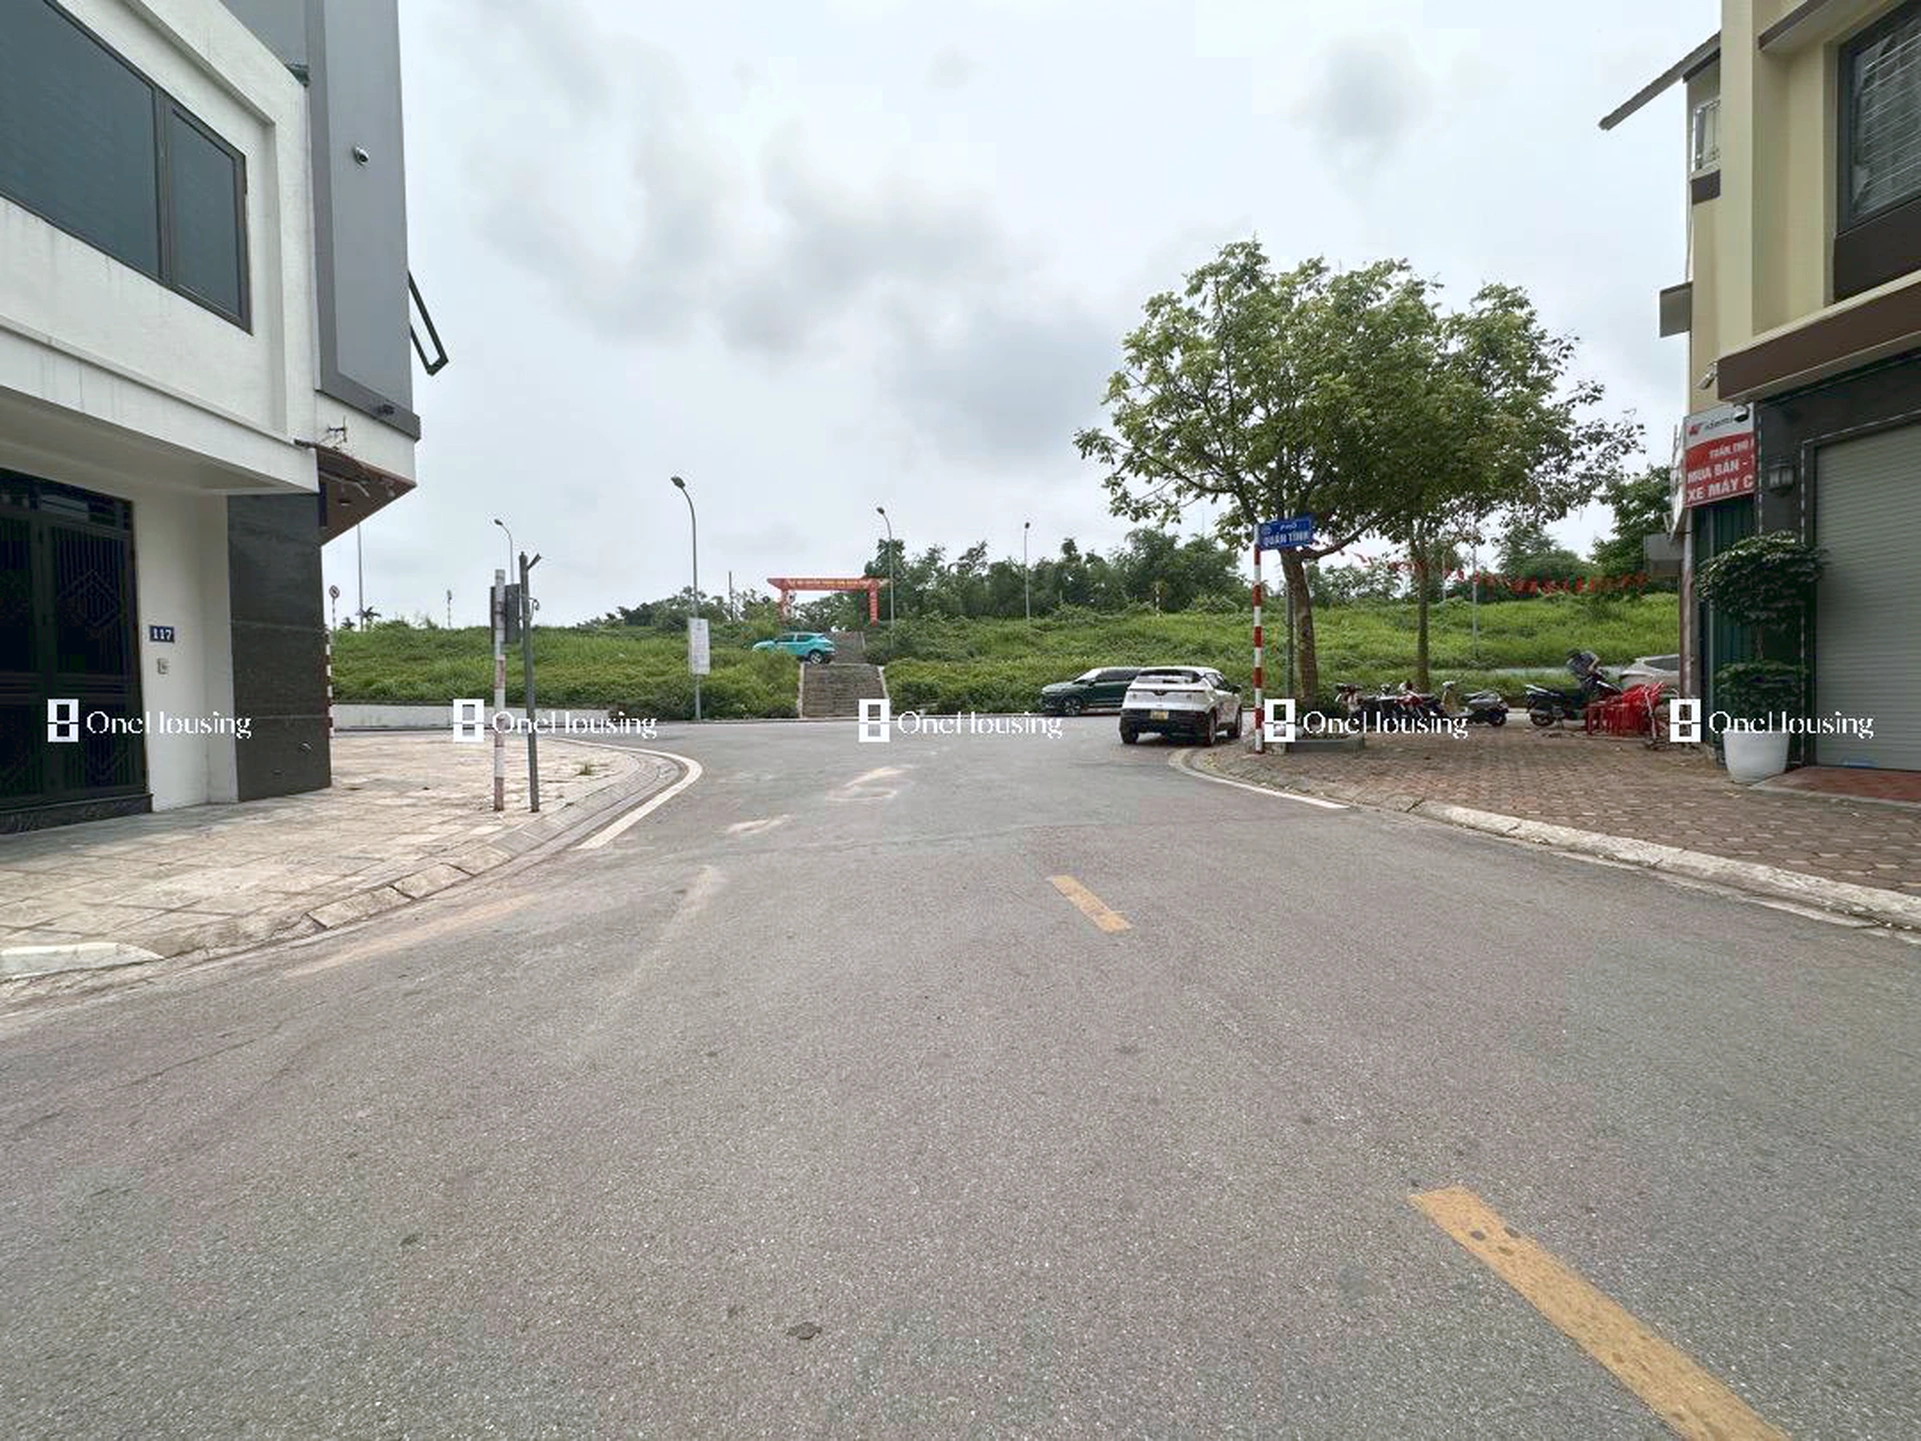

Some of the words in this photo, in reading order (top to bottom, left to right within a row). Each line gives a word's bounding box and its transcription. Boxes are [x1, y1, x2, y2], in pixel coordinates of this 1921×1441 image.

[1687, 466, 1712, 484] MUA
[1687, 487, 1704, 503] XE
[153, 627, 172, 641] 117
